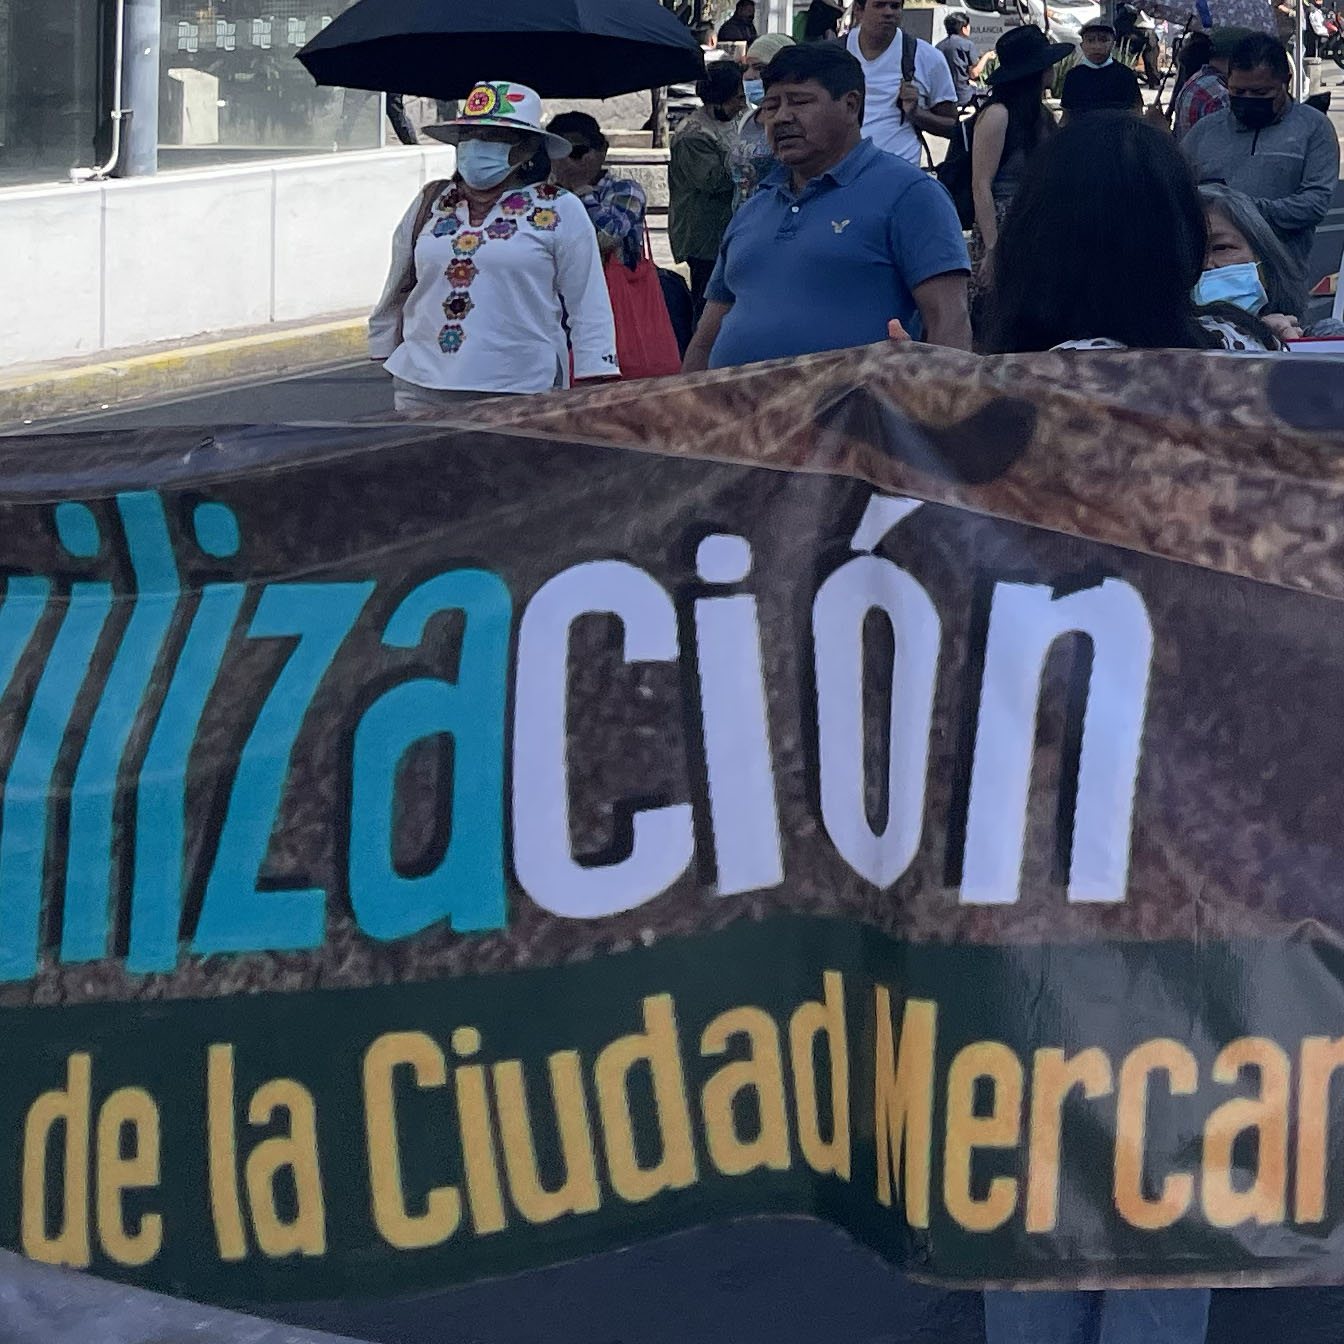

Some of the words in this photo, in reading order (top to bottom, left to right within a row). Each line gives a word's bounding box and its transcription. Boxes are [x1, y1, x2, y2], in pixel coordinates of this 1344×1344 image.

[21, 1053, 162, 1267] de
[207, 1042, 328, 1262] la
[362, 970, 852, 1254] Ciudad
